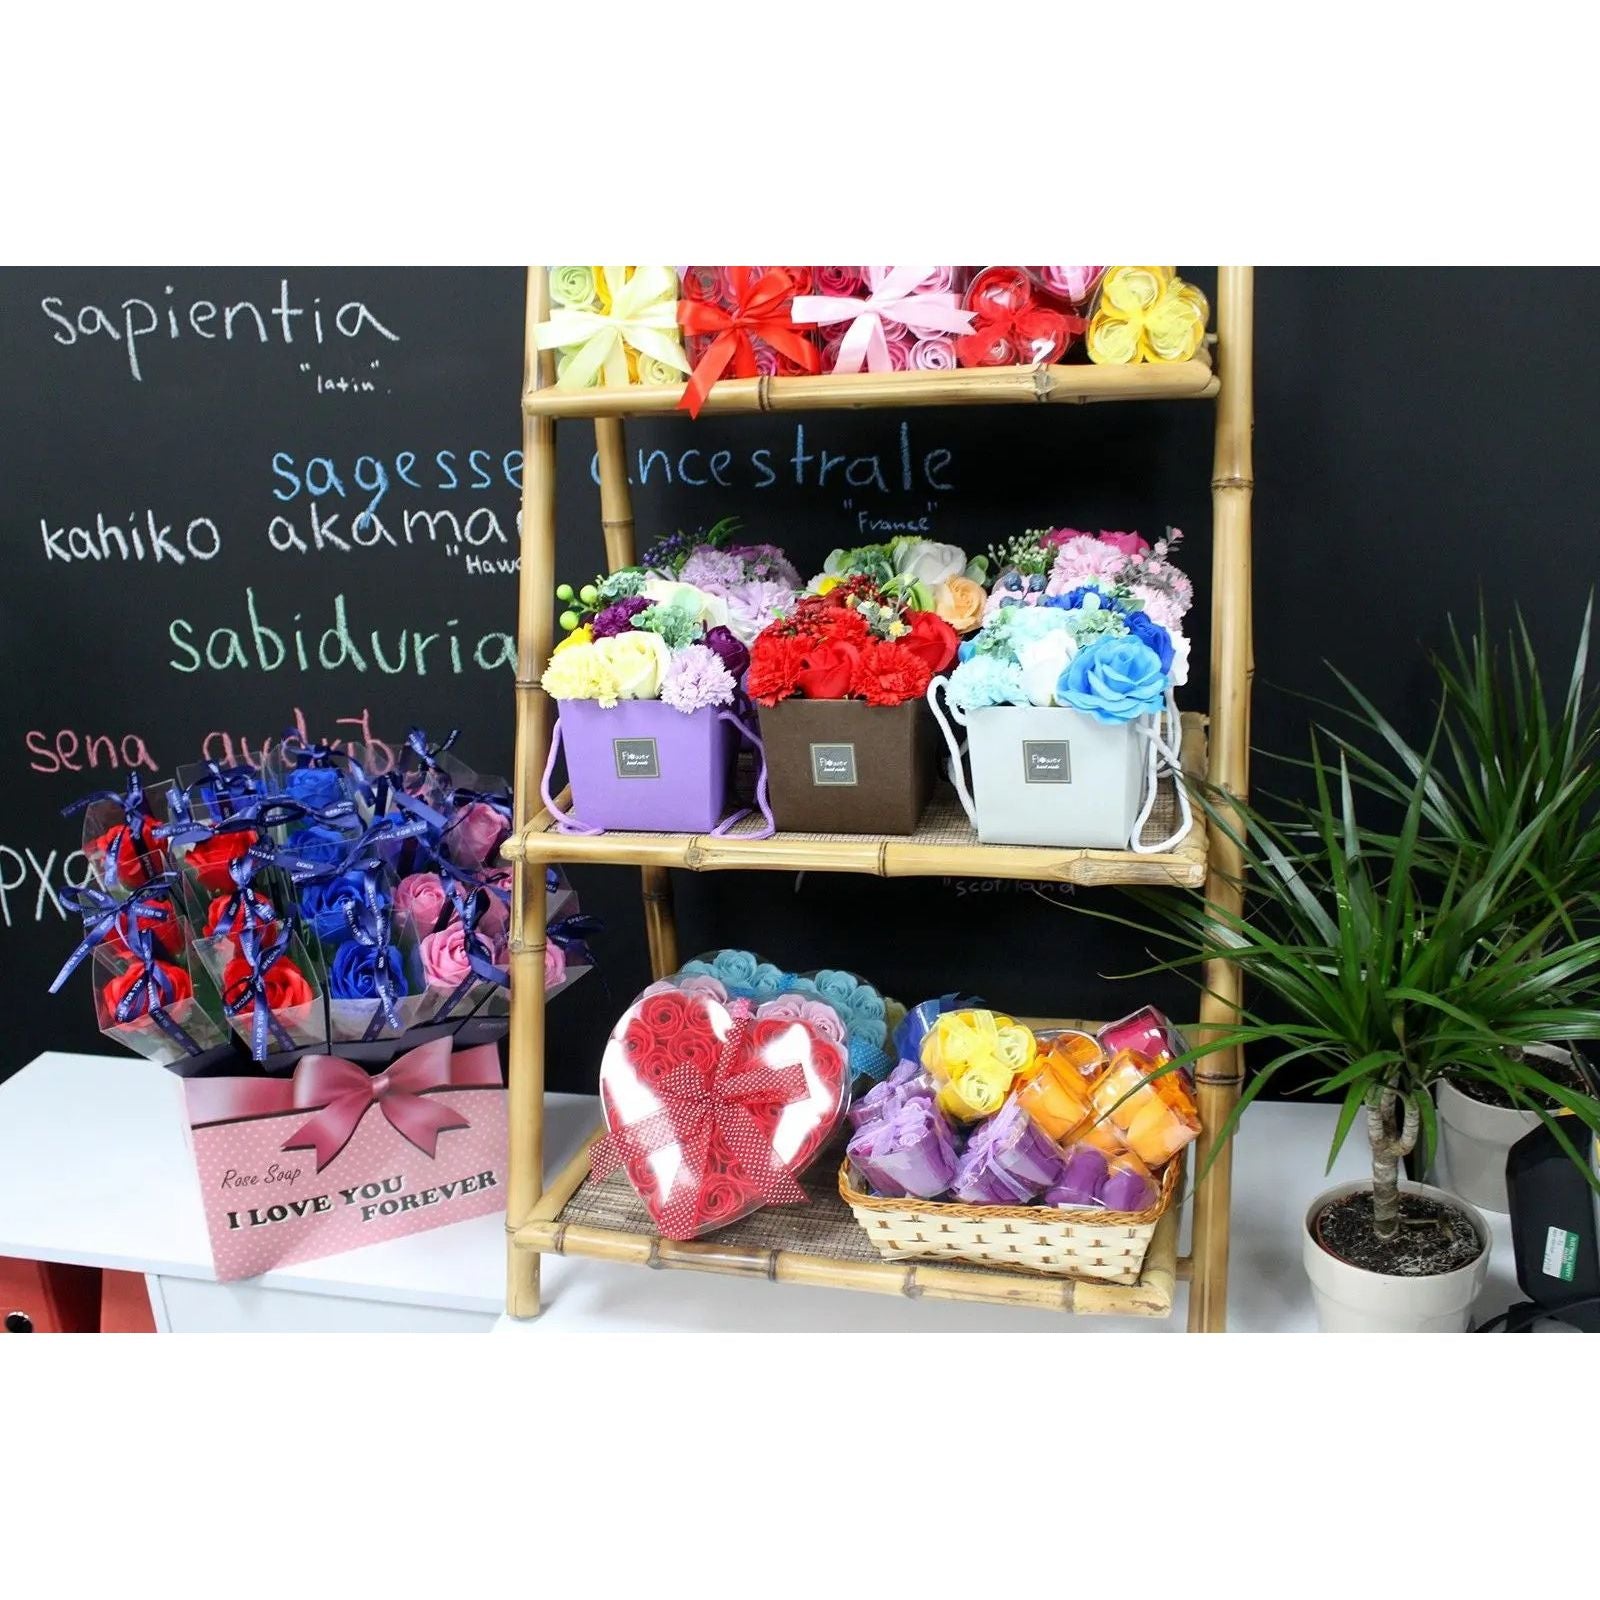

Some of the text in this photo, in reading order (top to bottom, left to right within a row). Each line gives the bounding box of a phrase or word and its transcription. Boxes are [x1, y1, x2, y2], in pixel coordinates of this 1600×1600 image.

[41, 279, 399, 381] sapientia
[271, 420, 954, 530] sagesse ncestrale
[40, 509, 221, 564] kahiko
[26, 729, 159, 773] sena
[220, 1163, 302, 1190] Rose Soap
[227, 1174, 404, 1230] I LOVE YOU
[360, 1169, 497, 1223] FOREVER
